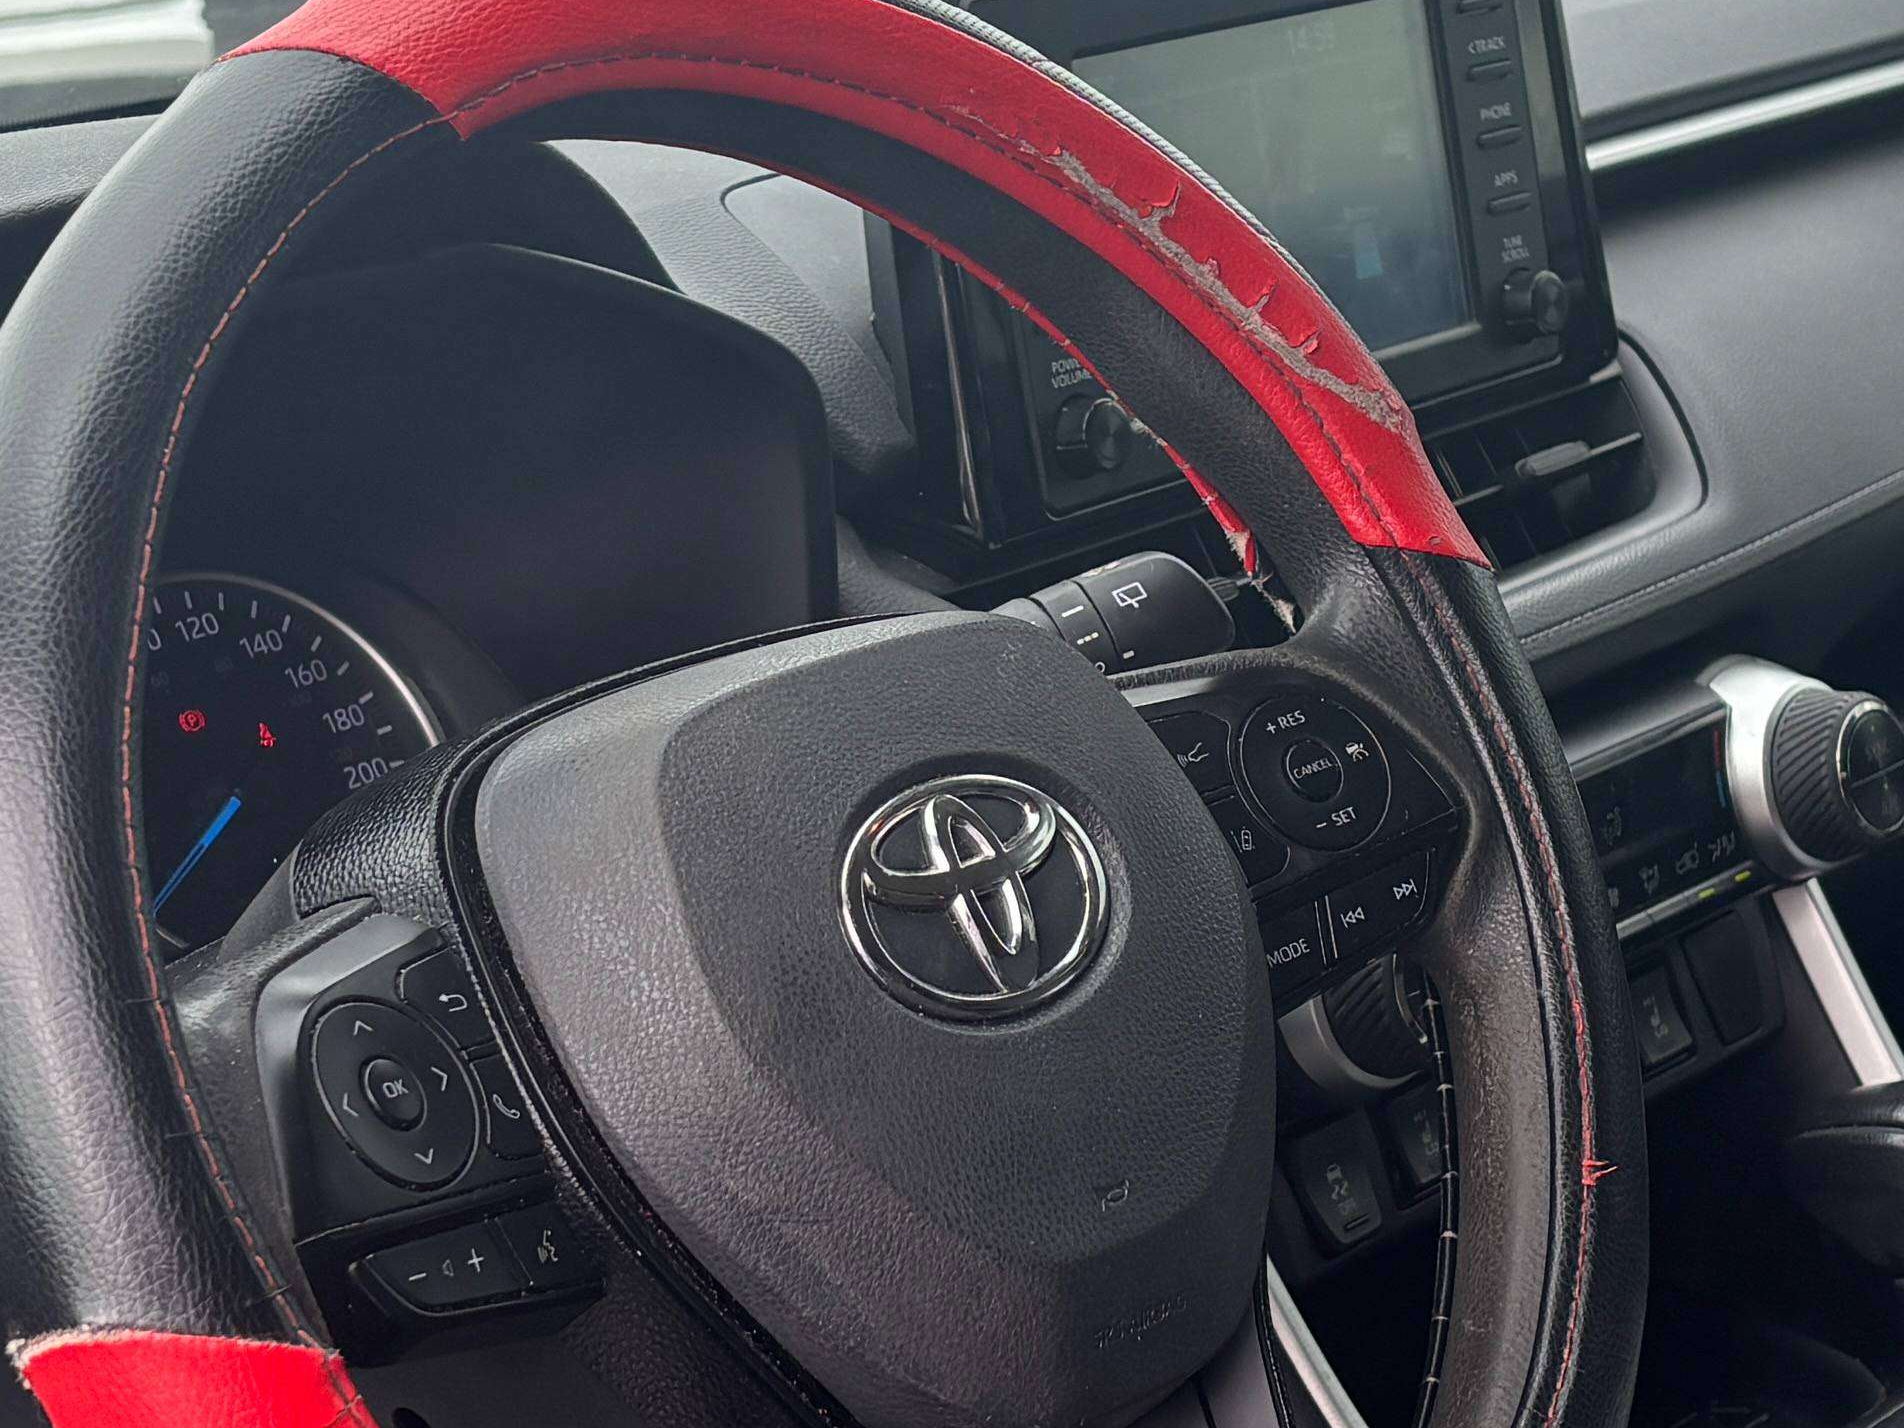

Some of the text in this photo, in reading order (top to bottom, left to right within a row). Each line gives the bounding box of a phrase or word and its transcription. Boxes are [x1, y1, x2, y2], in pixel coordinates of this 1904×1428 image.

[175, 612, 220, 642] 120
[239, 629, 284, 659] 140
[284, 659, 328, 689] 160
[322, 704, 365, 734] 180
[1277, 710, 1306, 729] RES
[343, 757, 389, 789] 200
[1294, 758, 1332, 779] CANCEL
[1331, 806, 1357, 826] SET
[1266, 938, 1311, 968] MODE
[382, 1079, 409, 1098] OK
